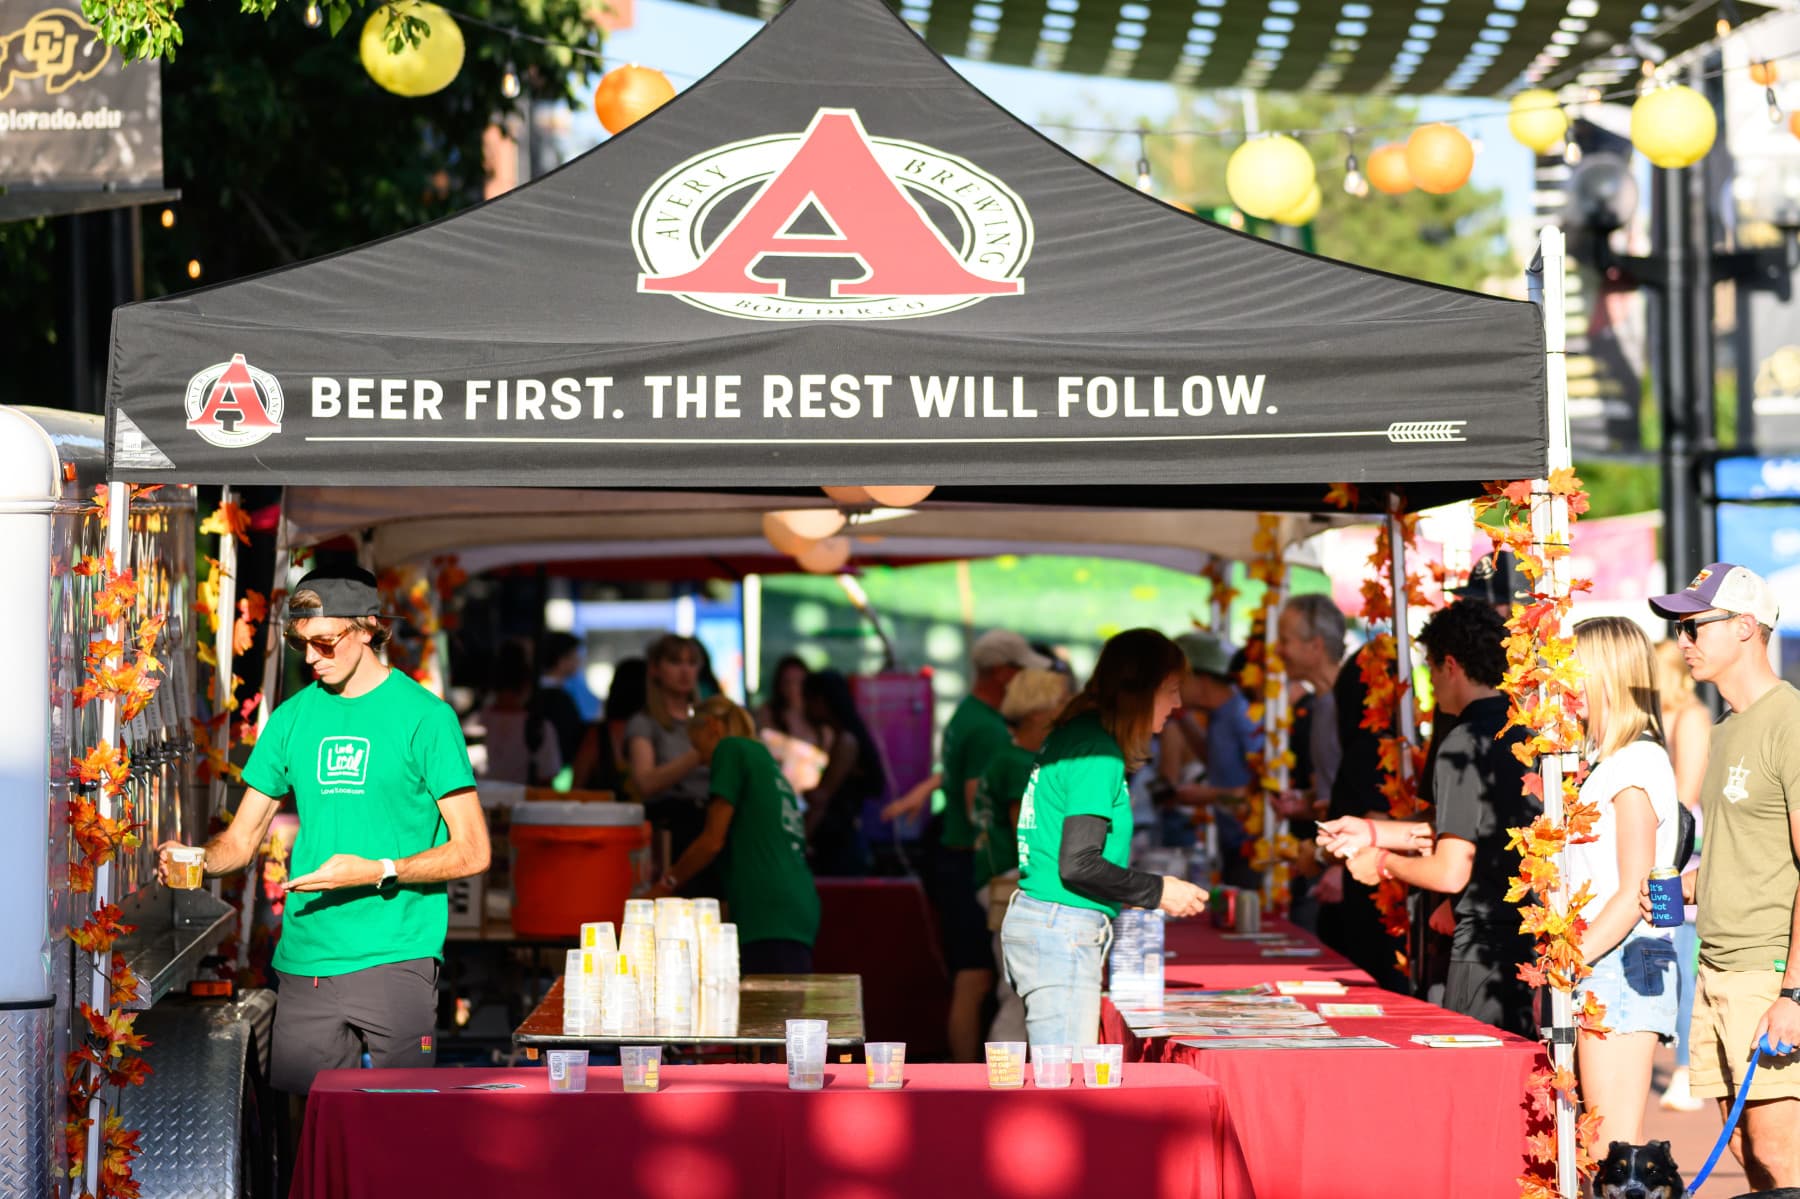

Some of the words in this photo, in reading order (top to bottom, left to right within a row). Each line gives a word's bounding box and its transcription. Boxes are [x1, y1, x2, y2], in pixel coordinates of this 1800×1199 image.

[655, 164, 728, 241] AVERY
[904, 158, 1012, 267] BREWING
[311, 376, 444, 420] BEER
[465, 376, 625, 420] FIRST.
[644, 375, 742, 419] THE
[763, 373, 893, 419] REST
[909, 375, 1038, 418] WILL
[1058, 374, 1279, 418] FOLLOW.
[1651, 894, 1672, 902] Live,
[1652, 912, 1673, 920] Live.
